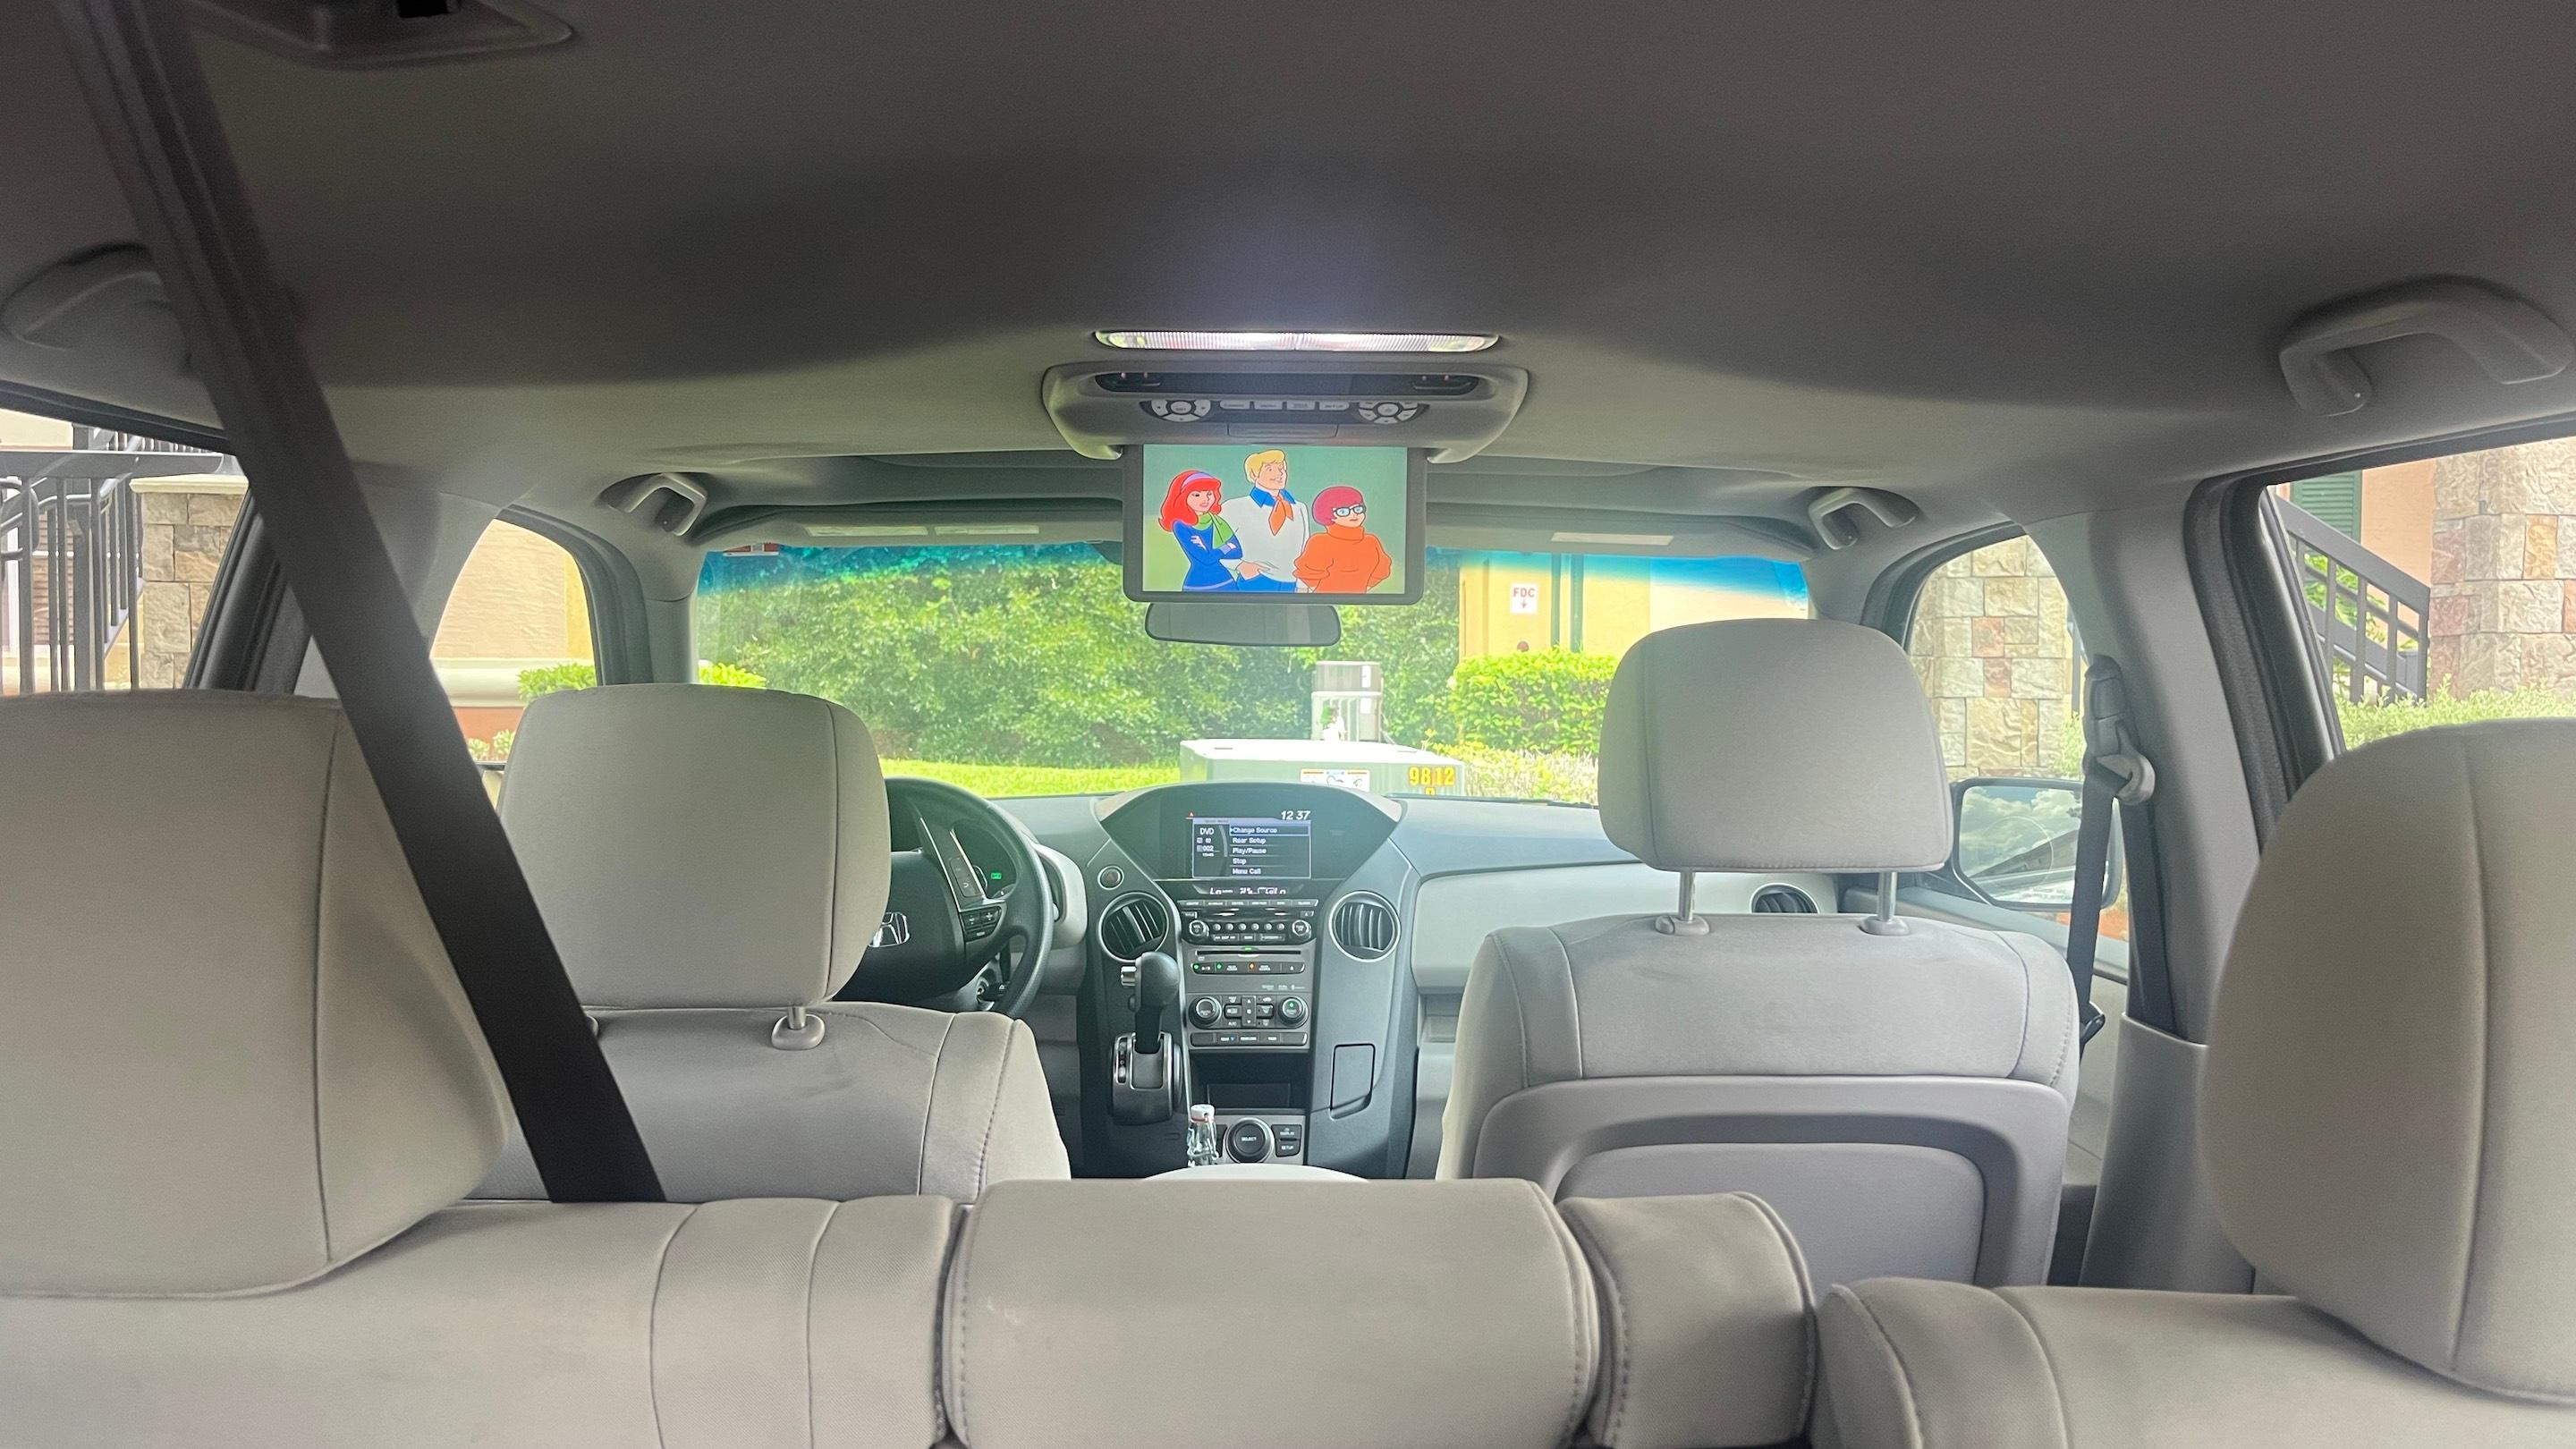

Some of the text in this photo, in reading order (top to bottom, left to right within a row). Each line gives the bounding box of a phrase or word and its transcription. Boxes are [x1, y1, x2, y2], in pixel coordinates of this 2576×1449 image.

[1513, 587, 1536, 598] FDC
[1409, 766, 1455, 786] 9812
[1199, 827, 1215, 835] DVD
[1249, 837, 1267, 845] Setup
[1232, 847, 1267, 855] Play/Pause
